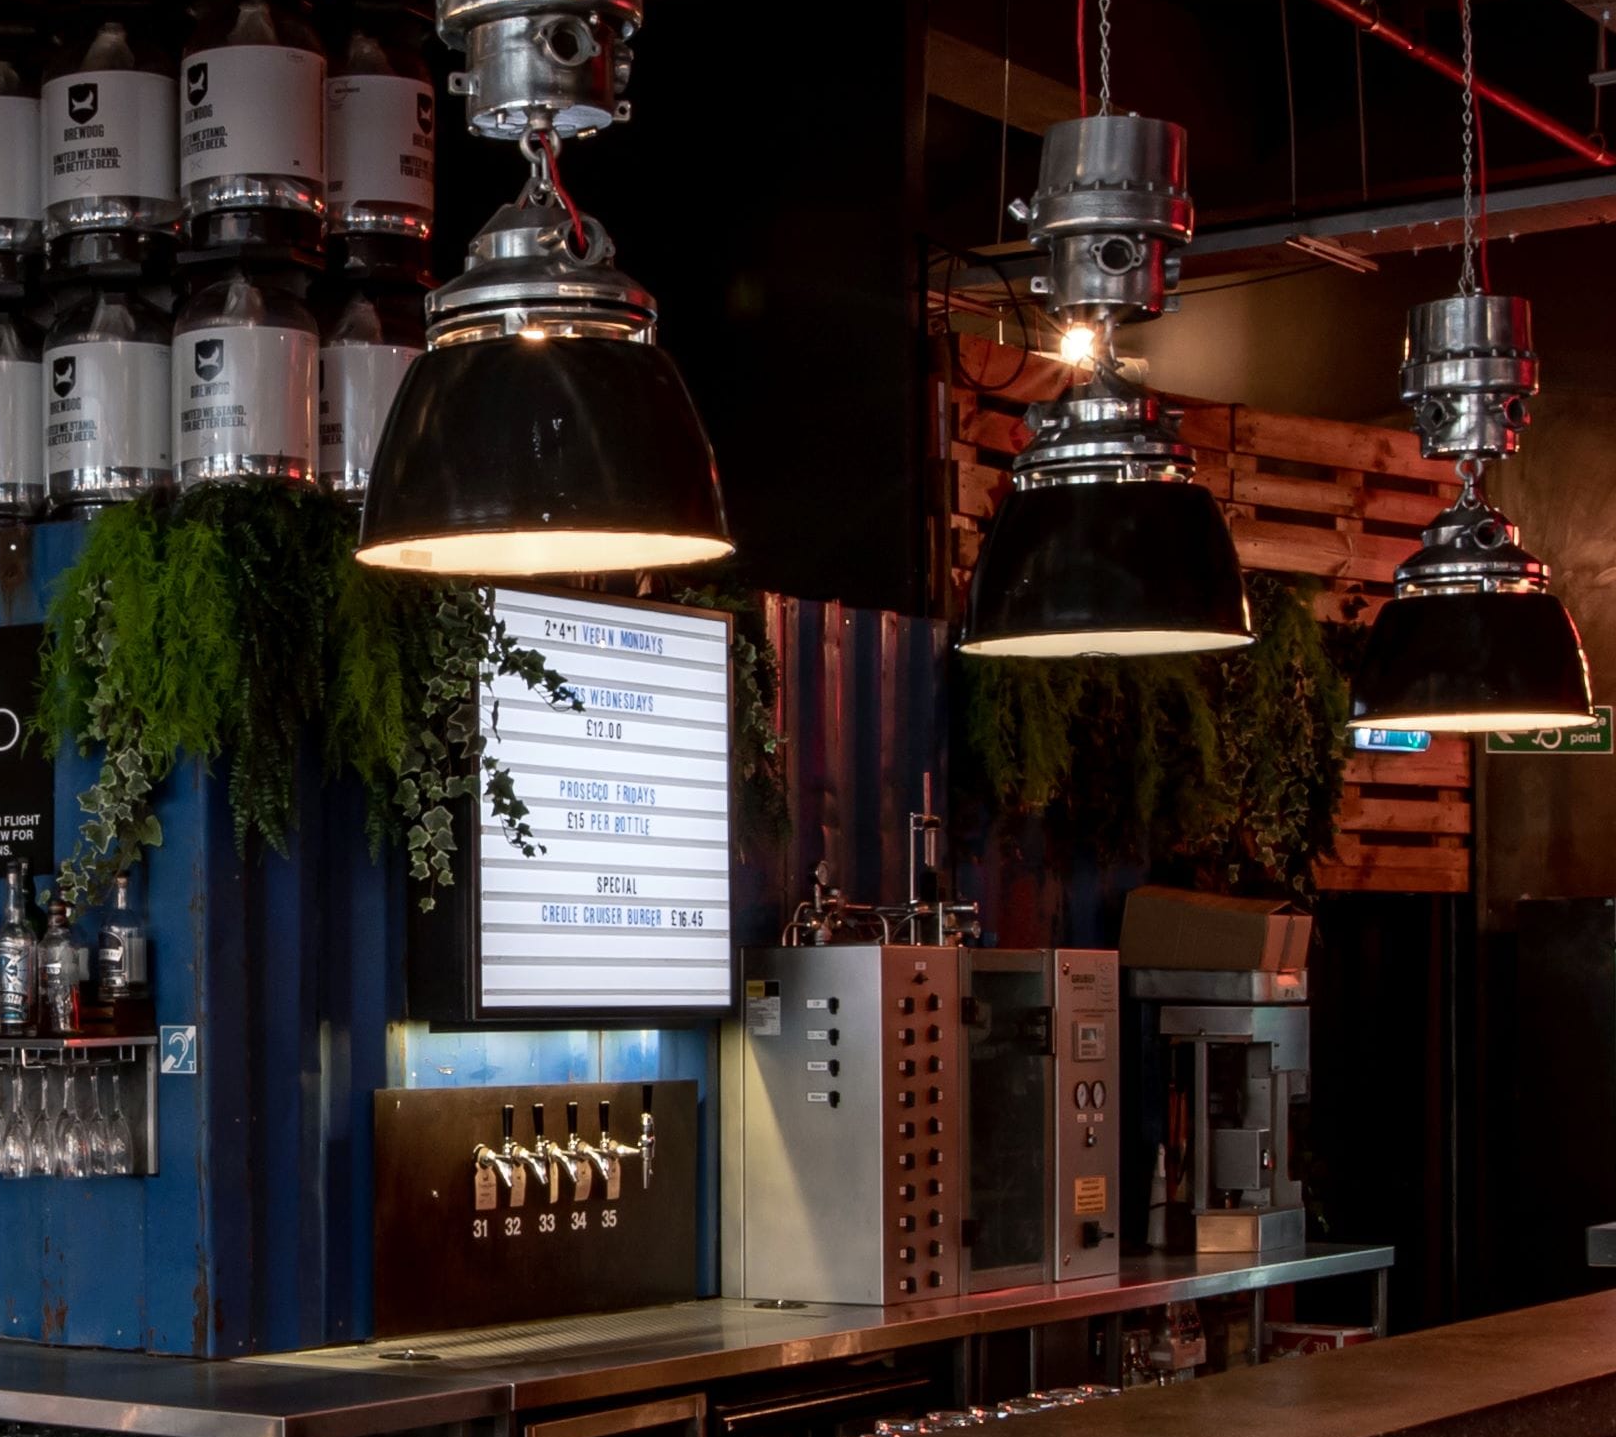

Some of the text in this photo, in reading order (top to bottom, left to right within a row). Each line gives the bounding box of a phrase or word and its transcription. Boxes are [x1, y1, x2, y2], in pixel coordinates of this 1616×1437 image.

[64, 124, 104, 142] BREWDOG
[78, 149, 89, 159] WE
[91, 147, 121, 157] STAND.
[66, 160, 94, 173] BETTER
[96, 159, 120, 169] BEER.
[583, 625, 614, 647] VEGAN
[620, 630, 663, 654] MONDAYS
[590, 688, 654, 712] WEDNESDAYS
[587, 719, 622, 739] £12.00
[1570, 731, 1601, 745] point
[560, 780, 655, 805] PROSECCO FRIDAYS
[4, 814, 40, 826] FLIGHT
[568, 812, 650, 836] £15 PER BOTTLE
[12, 829, 33, 840] FOR
[597, 876, 637, 895] SPECIAL
[542, 904, 703, 927] CREOLE CRUISER BURGER £16.45
[473, 1209, 618, 1238] 31 32 33 34 35
